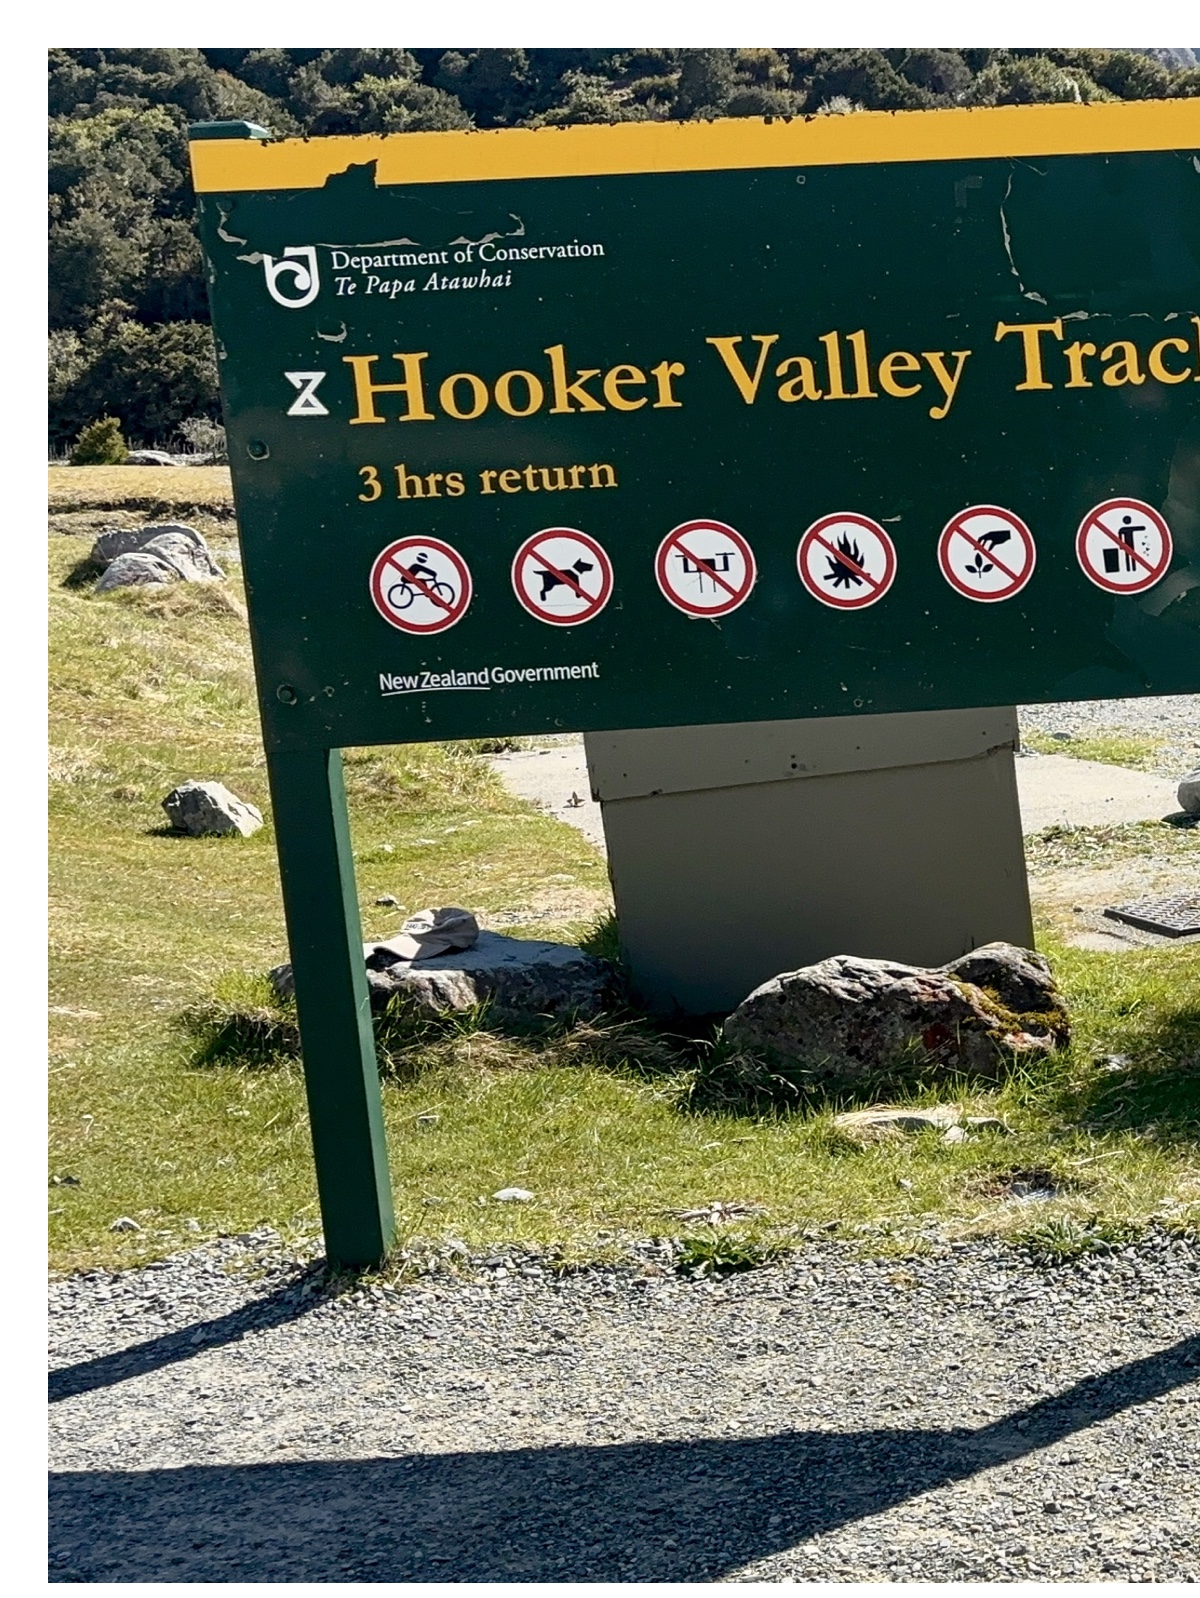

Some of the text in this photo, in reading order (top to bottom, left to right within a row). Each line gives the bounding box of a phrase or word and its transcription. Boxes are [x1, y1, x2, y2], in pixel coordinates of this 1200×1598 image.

[331, 239, 605, 274] Department of Conservation
[334, 269, 512, 299] Te Papa Atawhai
[342, 344, 685, 425] Hooker
[706, 328, 972, 420] Valley
[358, 462, 618, 502] 3 hrs return
[379, 662, 600, 691] New Zealand Government
